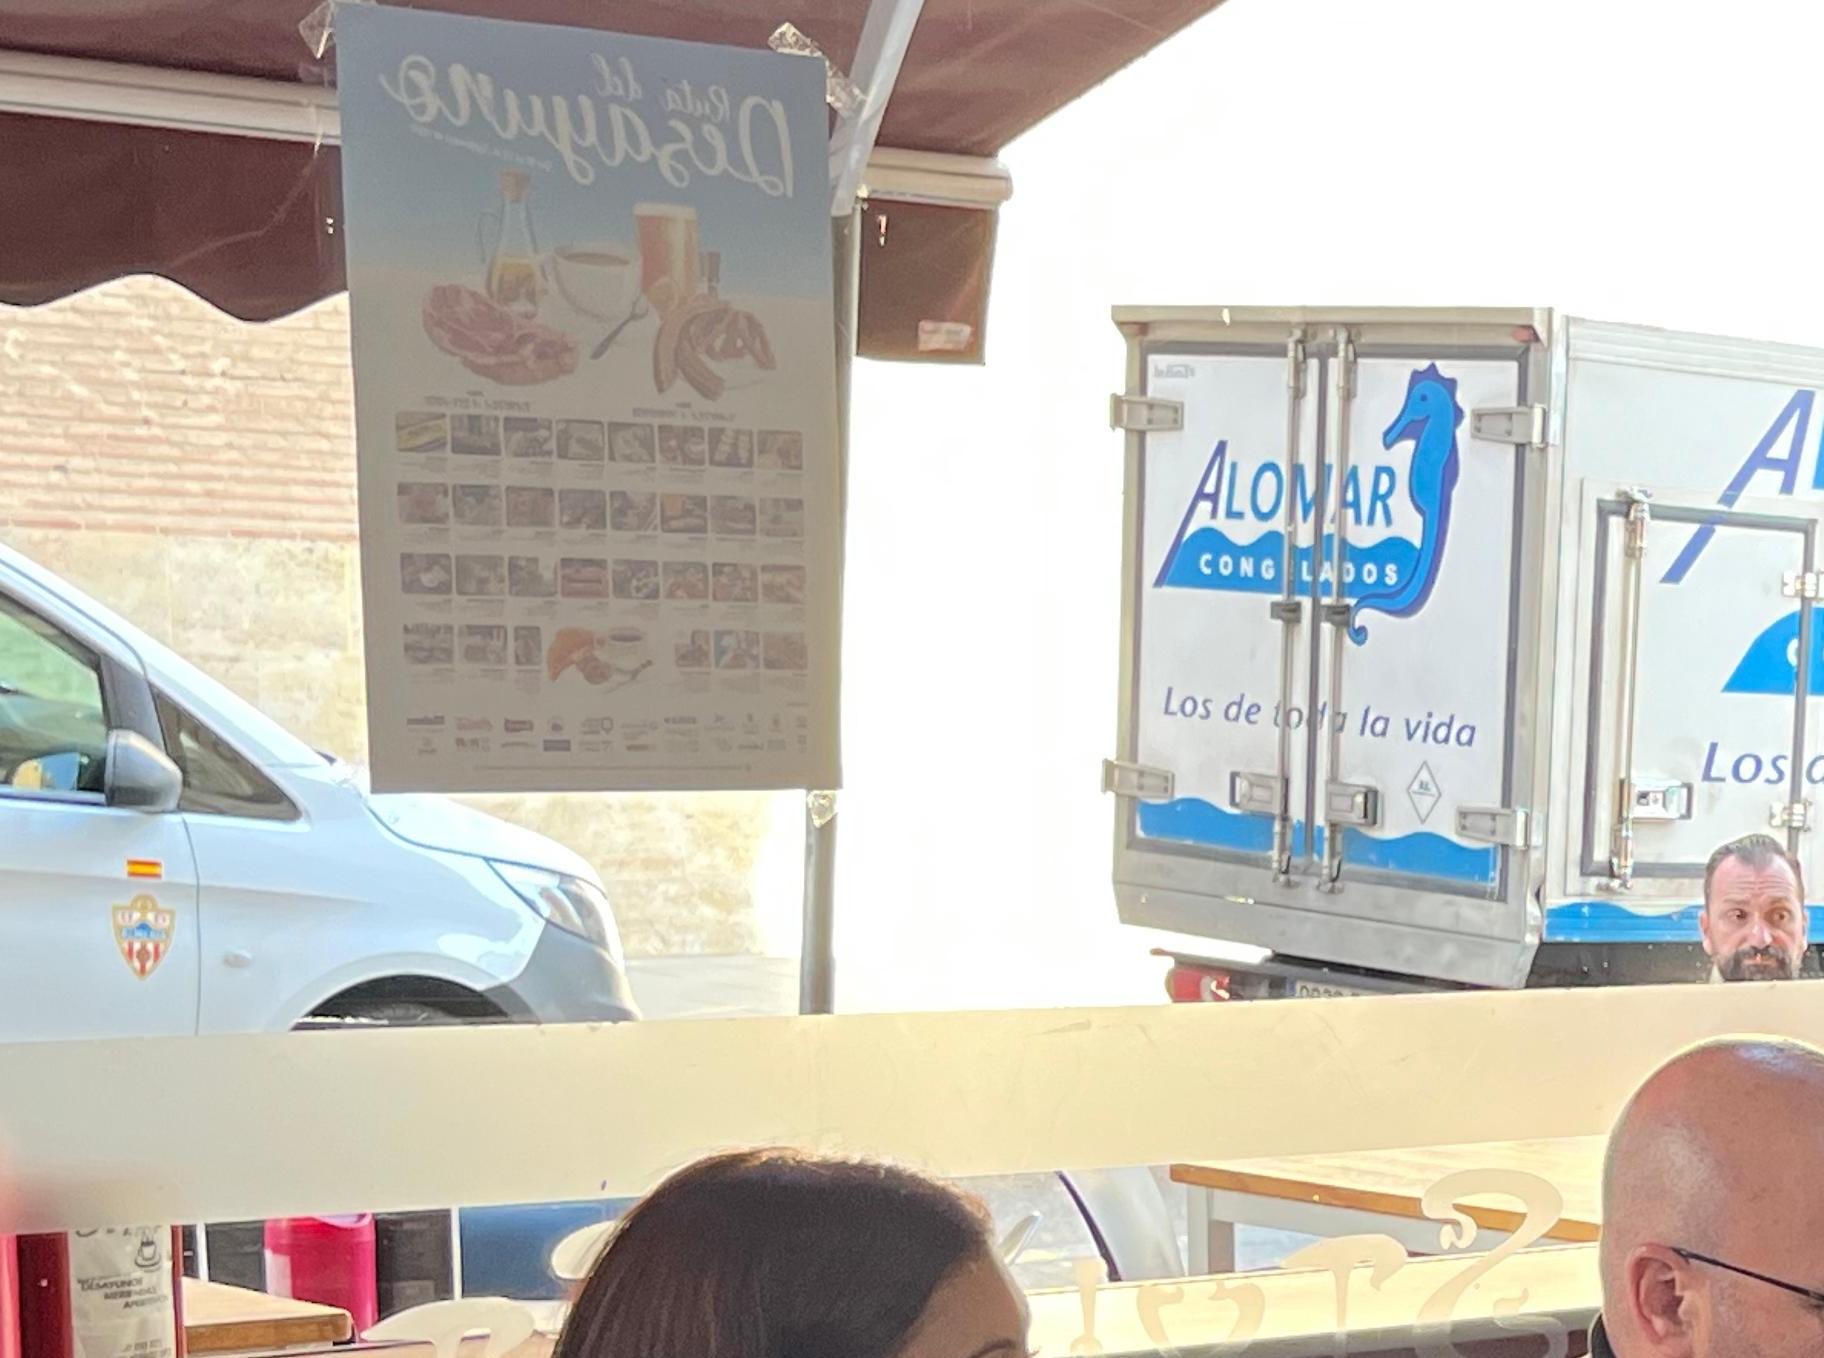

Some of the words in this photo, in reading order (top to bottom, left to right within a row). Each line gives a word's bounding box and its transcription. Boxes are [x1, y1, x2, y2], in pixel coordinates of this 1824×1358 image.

[1153, 439, 1397, 588] ALOMAR
[1199, 552, 1399, 587] CONGLADOS
[1162, 686, 1213, 721] Los
[1223, 692, 1262, 726] de
[1359, 705, 1391, 739] la
[1404, 711, 1477, 748] vida
[1701, 741, 1789, 785] Los
